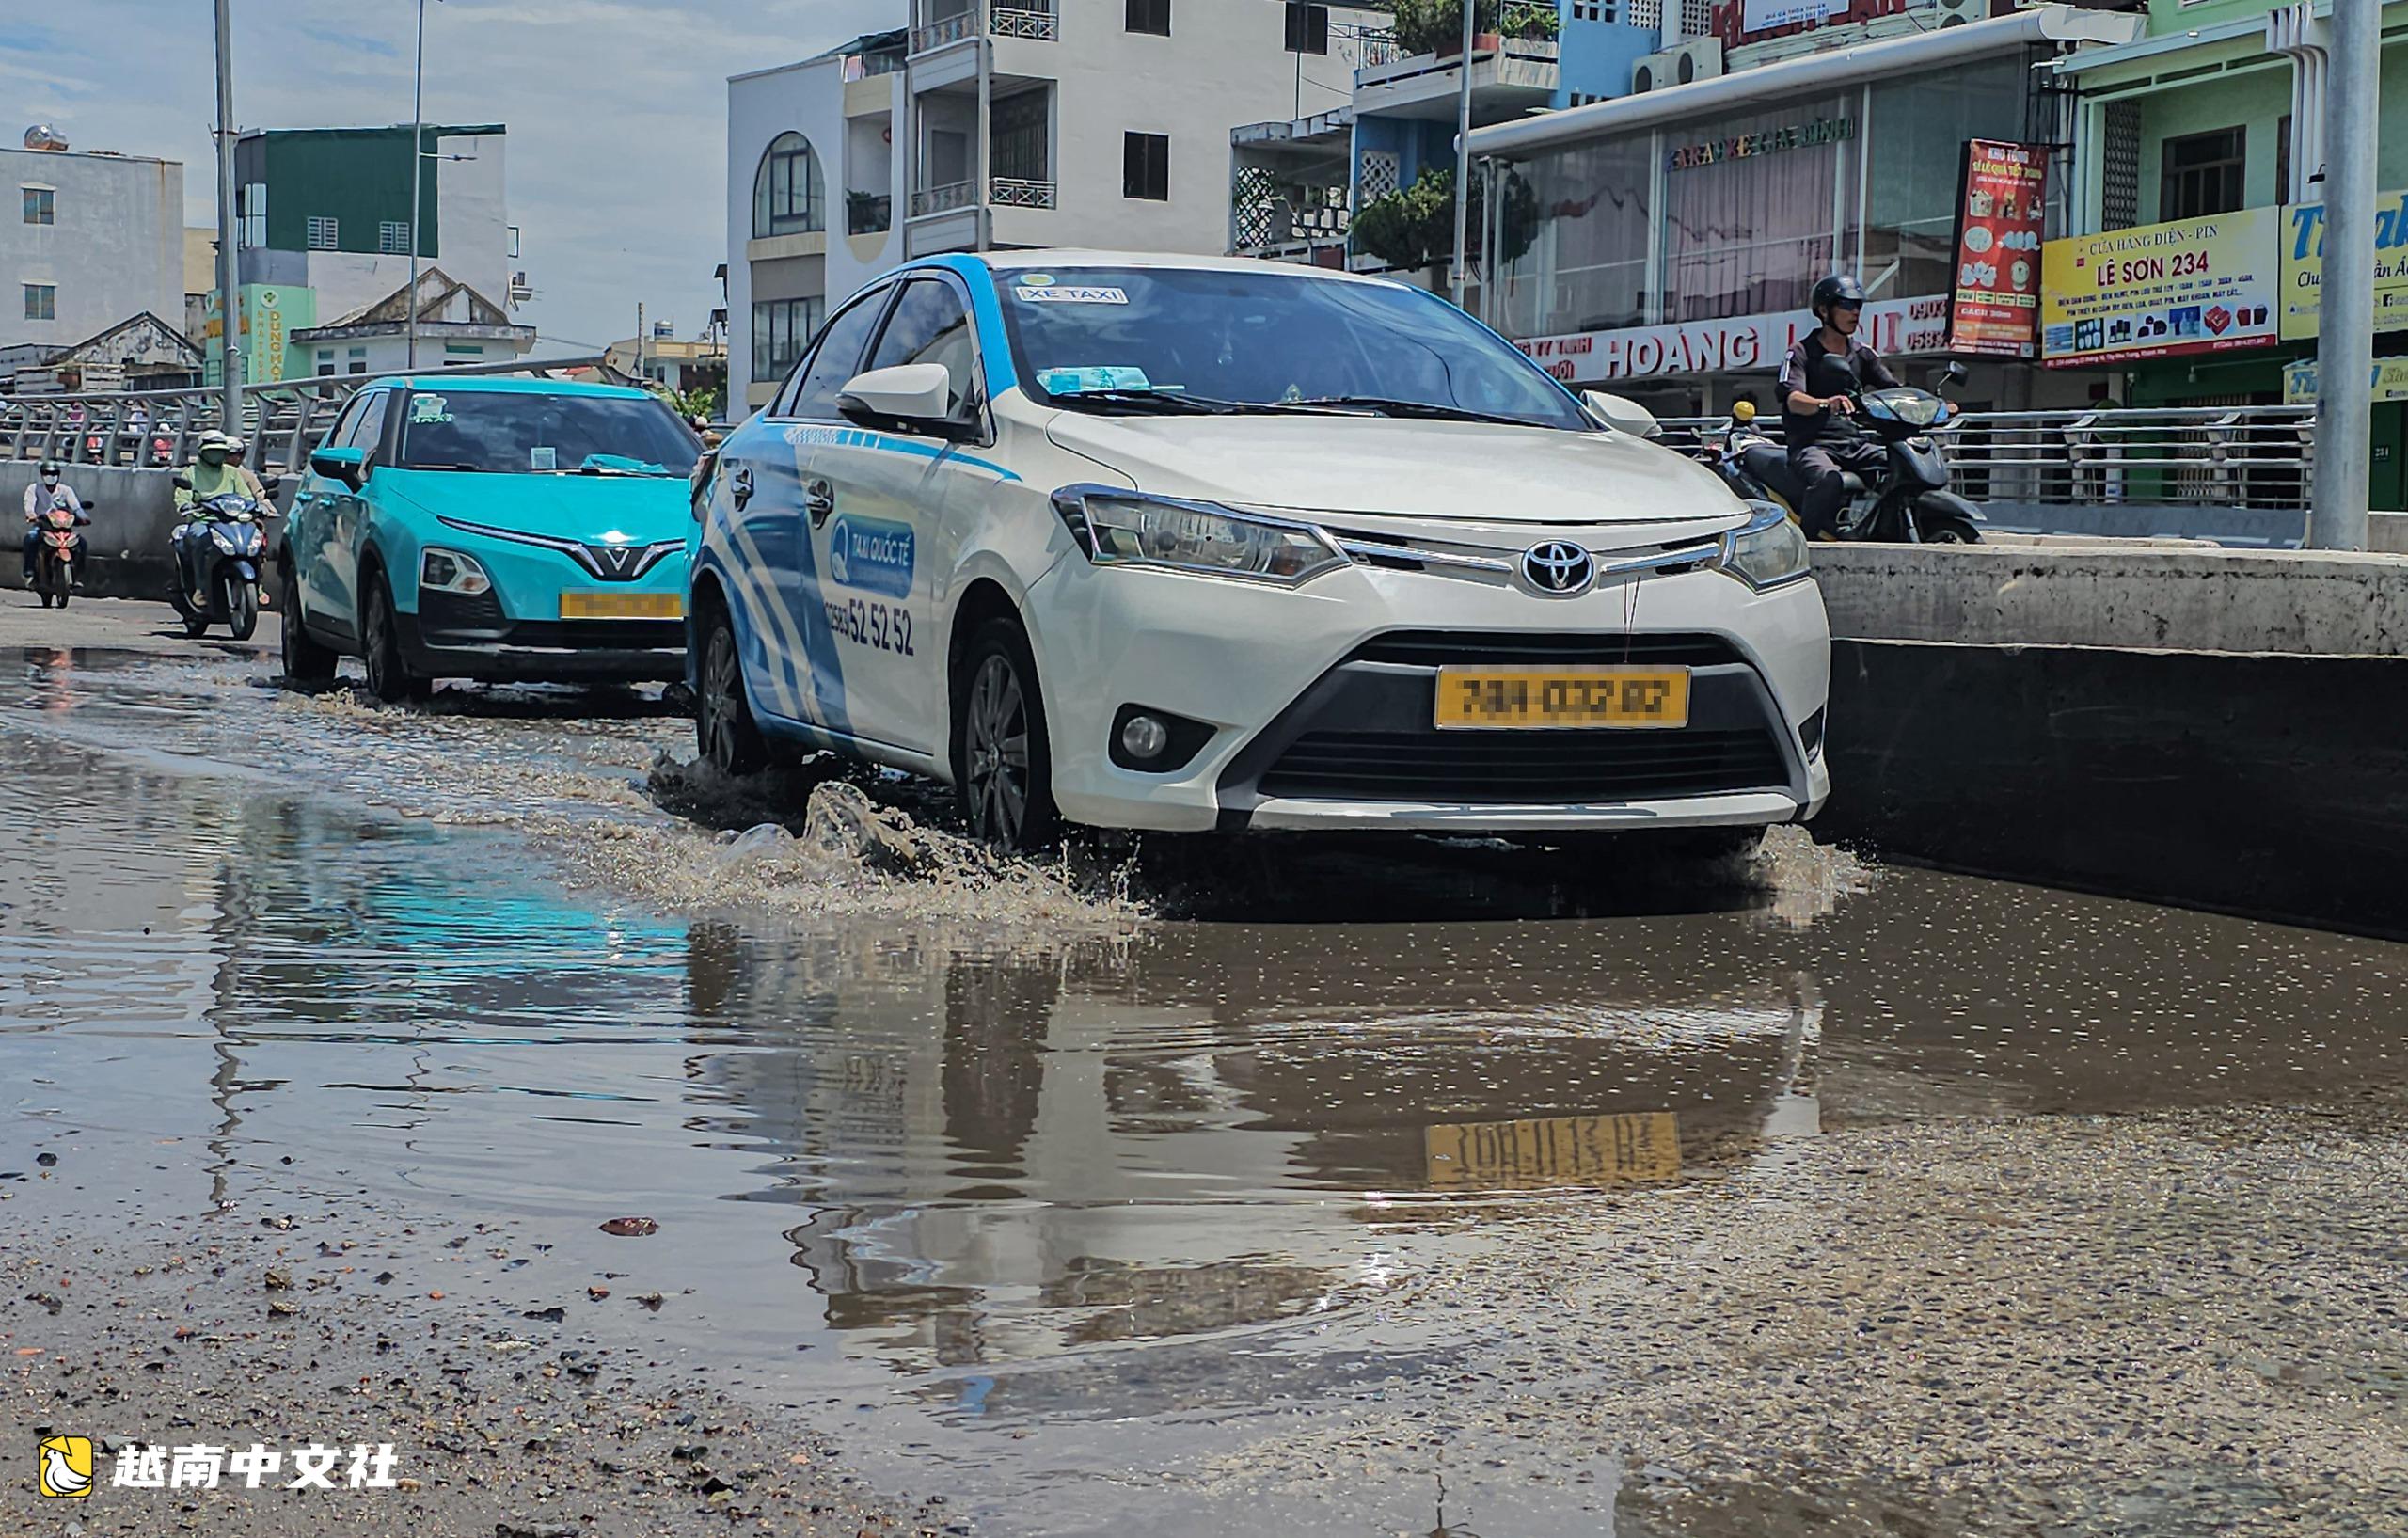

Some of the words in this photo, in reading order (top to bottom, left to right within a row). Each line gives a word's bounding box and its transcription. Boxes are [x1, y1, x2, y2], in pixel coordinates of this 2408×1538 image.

[2116, 234, 2151, 251] HÀNG
[2195, 224, 2218, 240] PIN
[2098, 258, 2115, 287] LÊ
[2122, 255, 2164, 283] SƠN
[2171, 250, 2210, 277] 234
[1027, 289, 1059, 299] XE
[1063, 289, 1118, 301] TAXI
[1608, 325, 1760, 378] HOÀNG
[851, 532, 870, 560] TAXI
[870, 530, 898, 565] QUỐC
[898, 533, 913, 567] TẾ
[848, 597, 868, 646] 52
[870, 602, 891, 651] 52
[893, 608, 915, 657] 52
